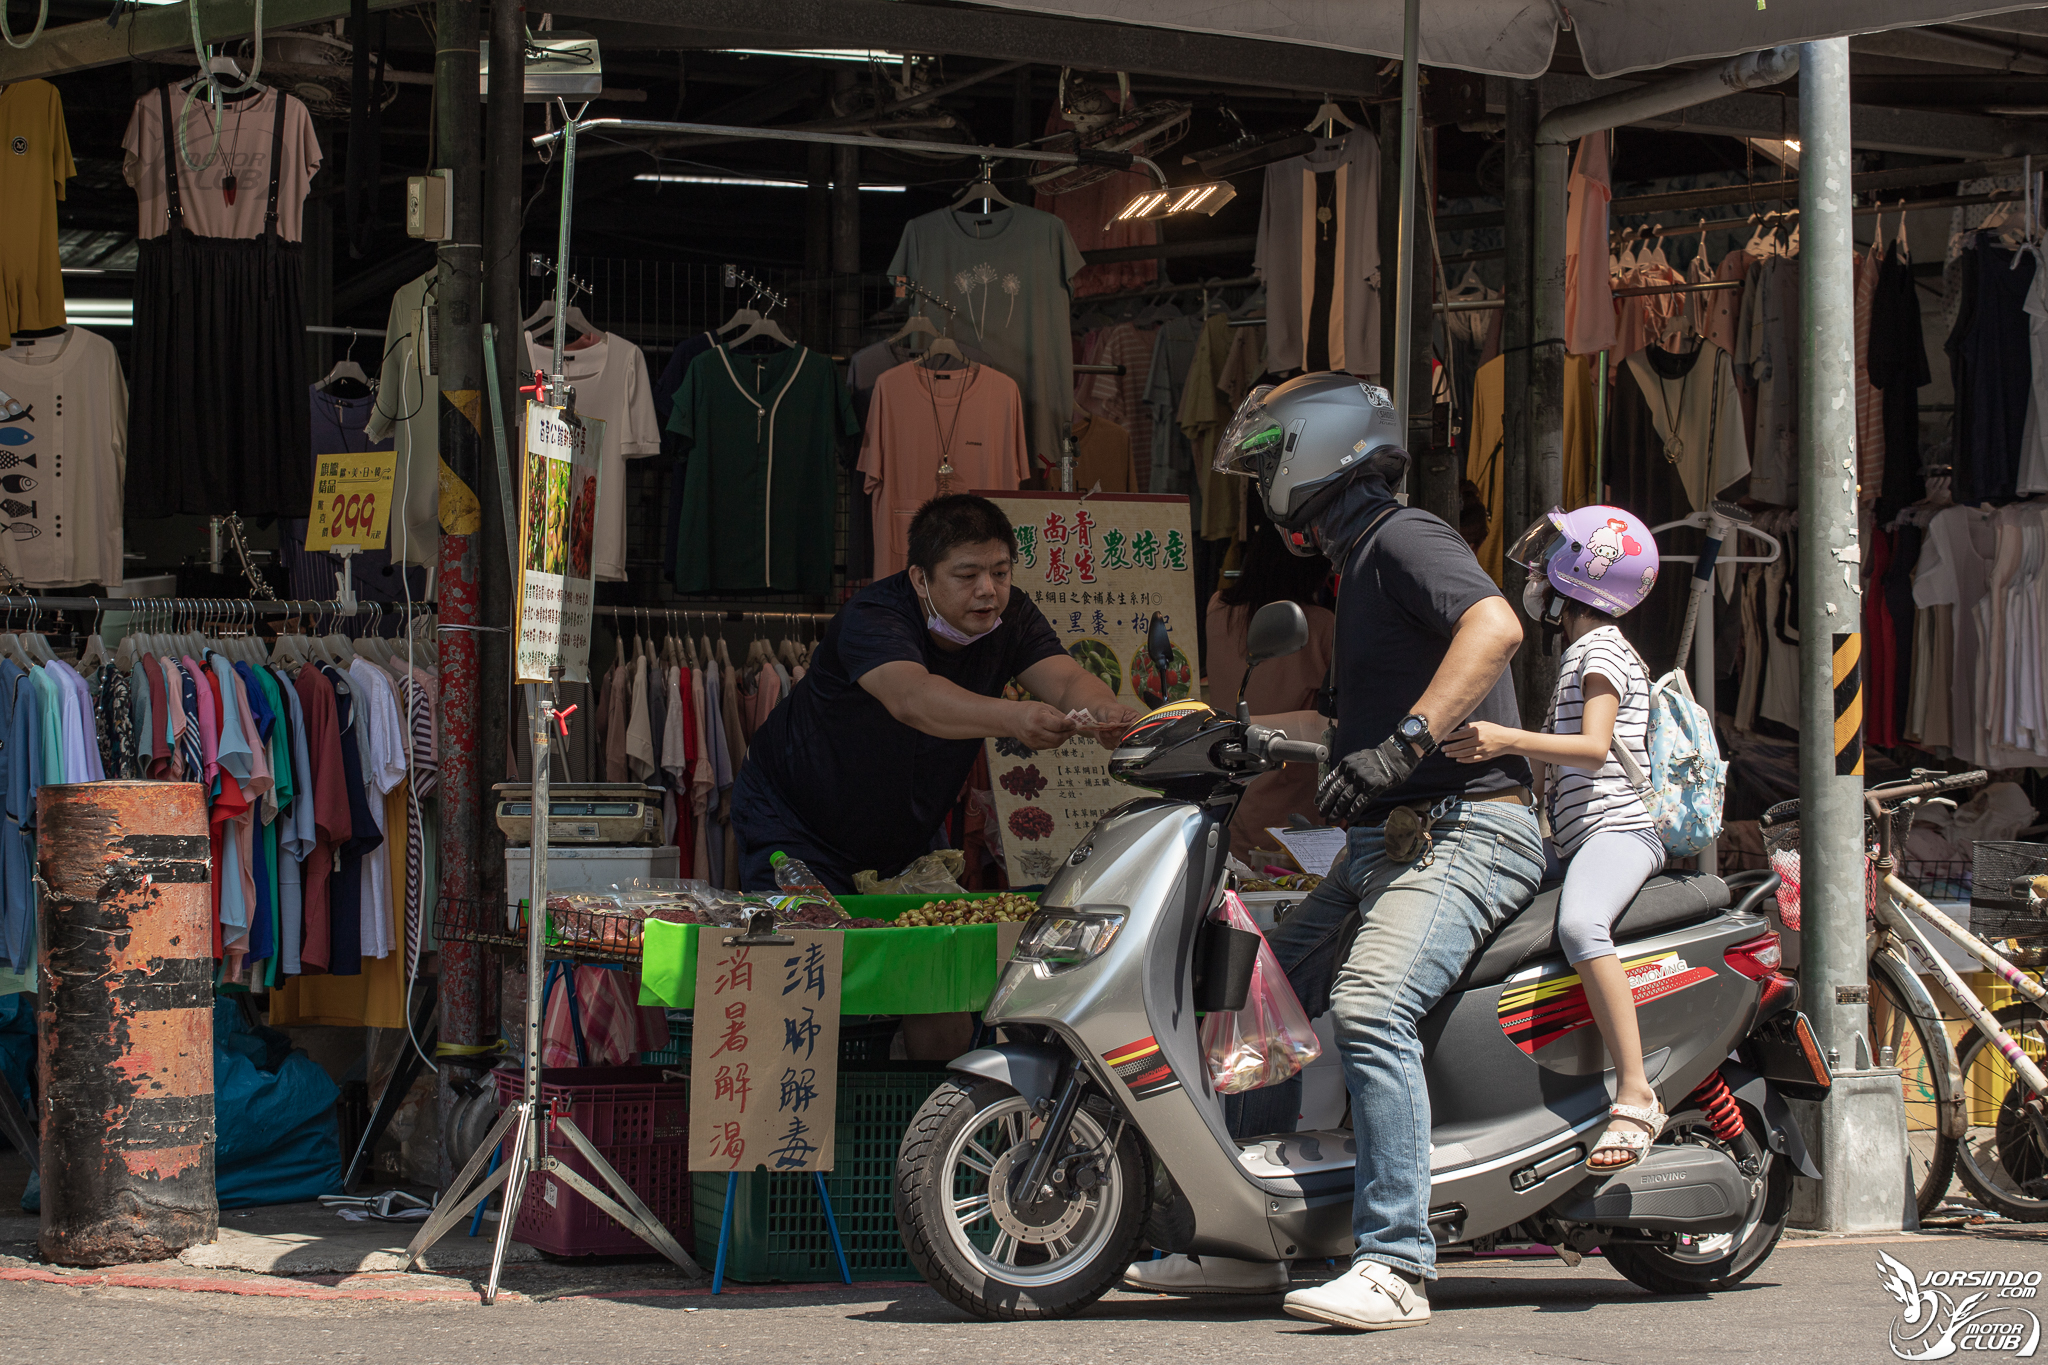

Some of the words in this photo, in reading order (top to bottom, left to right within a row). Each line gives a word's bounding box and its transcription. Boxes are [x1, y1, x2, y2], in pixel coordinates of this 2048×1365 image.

[318, 479, 337, 494] 精品
[331, 493, 375, 538] 299
[1025, 591, 1150, 606] 草綱目之食補養生系列
[709, 946, 753, 1169] 消暑解渴
[768, 942, 826, 1171] 清肺解毒
[1640, 1170, 1687, 1184] EMOVING
